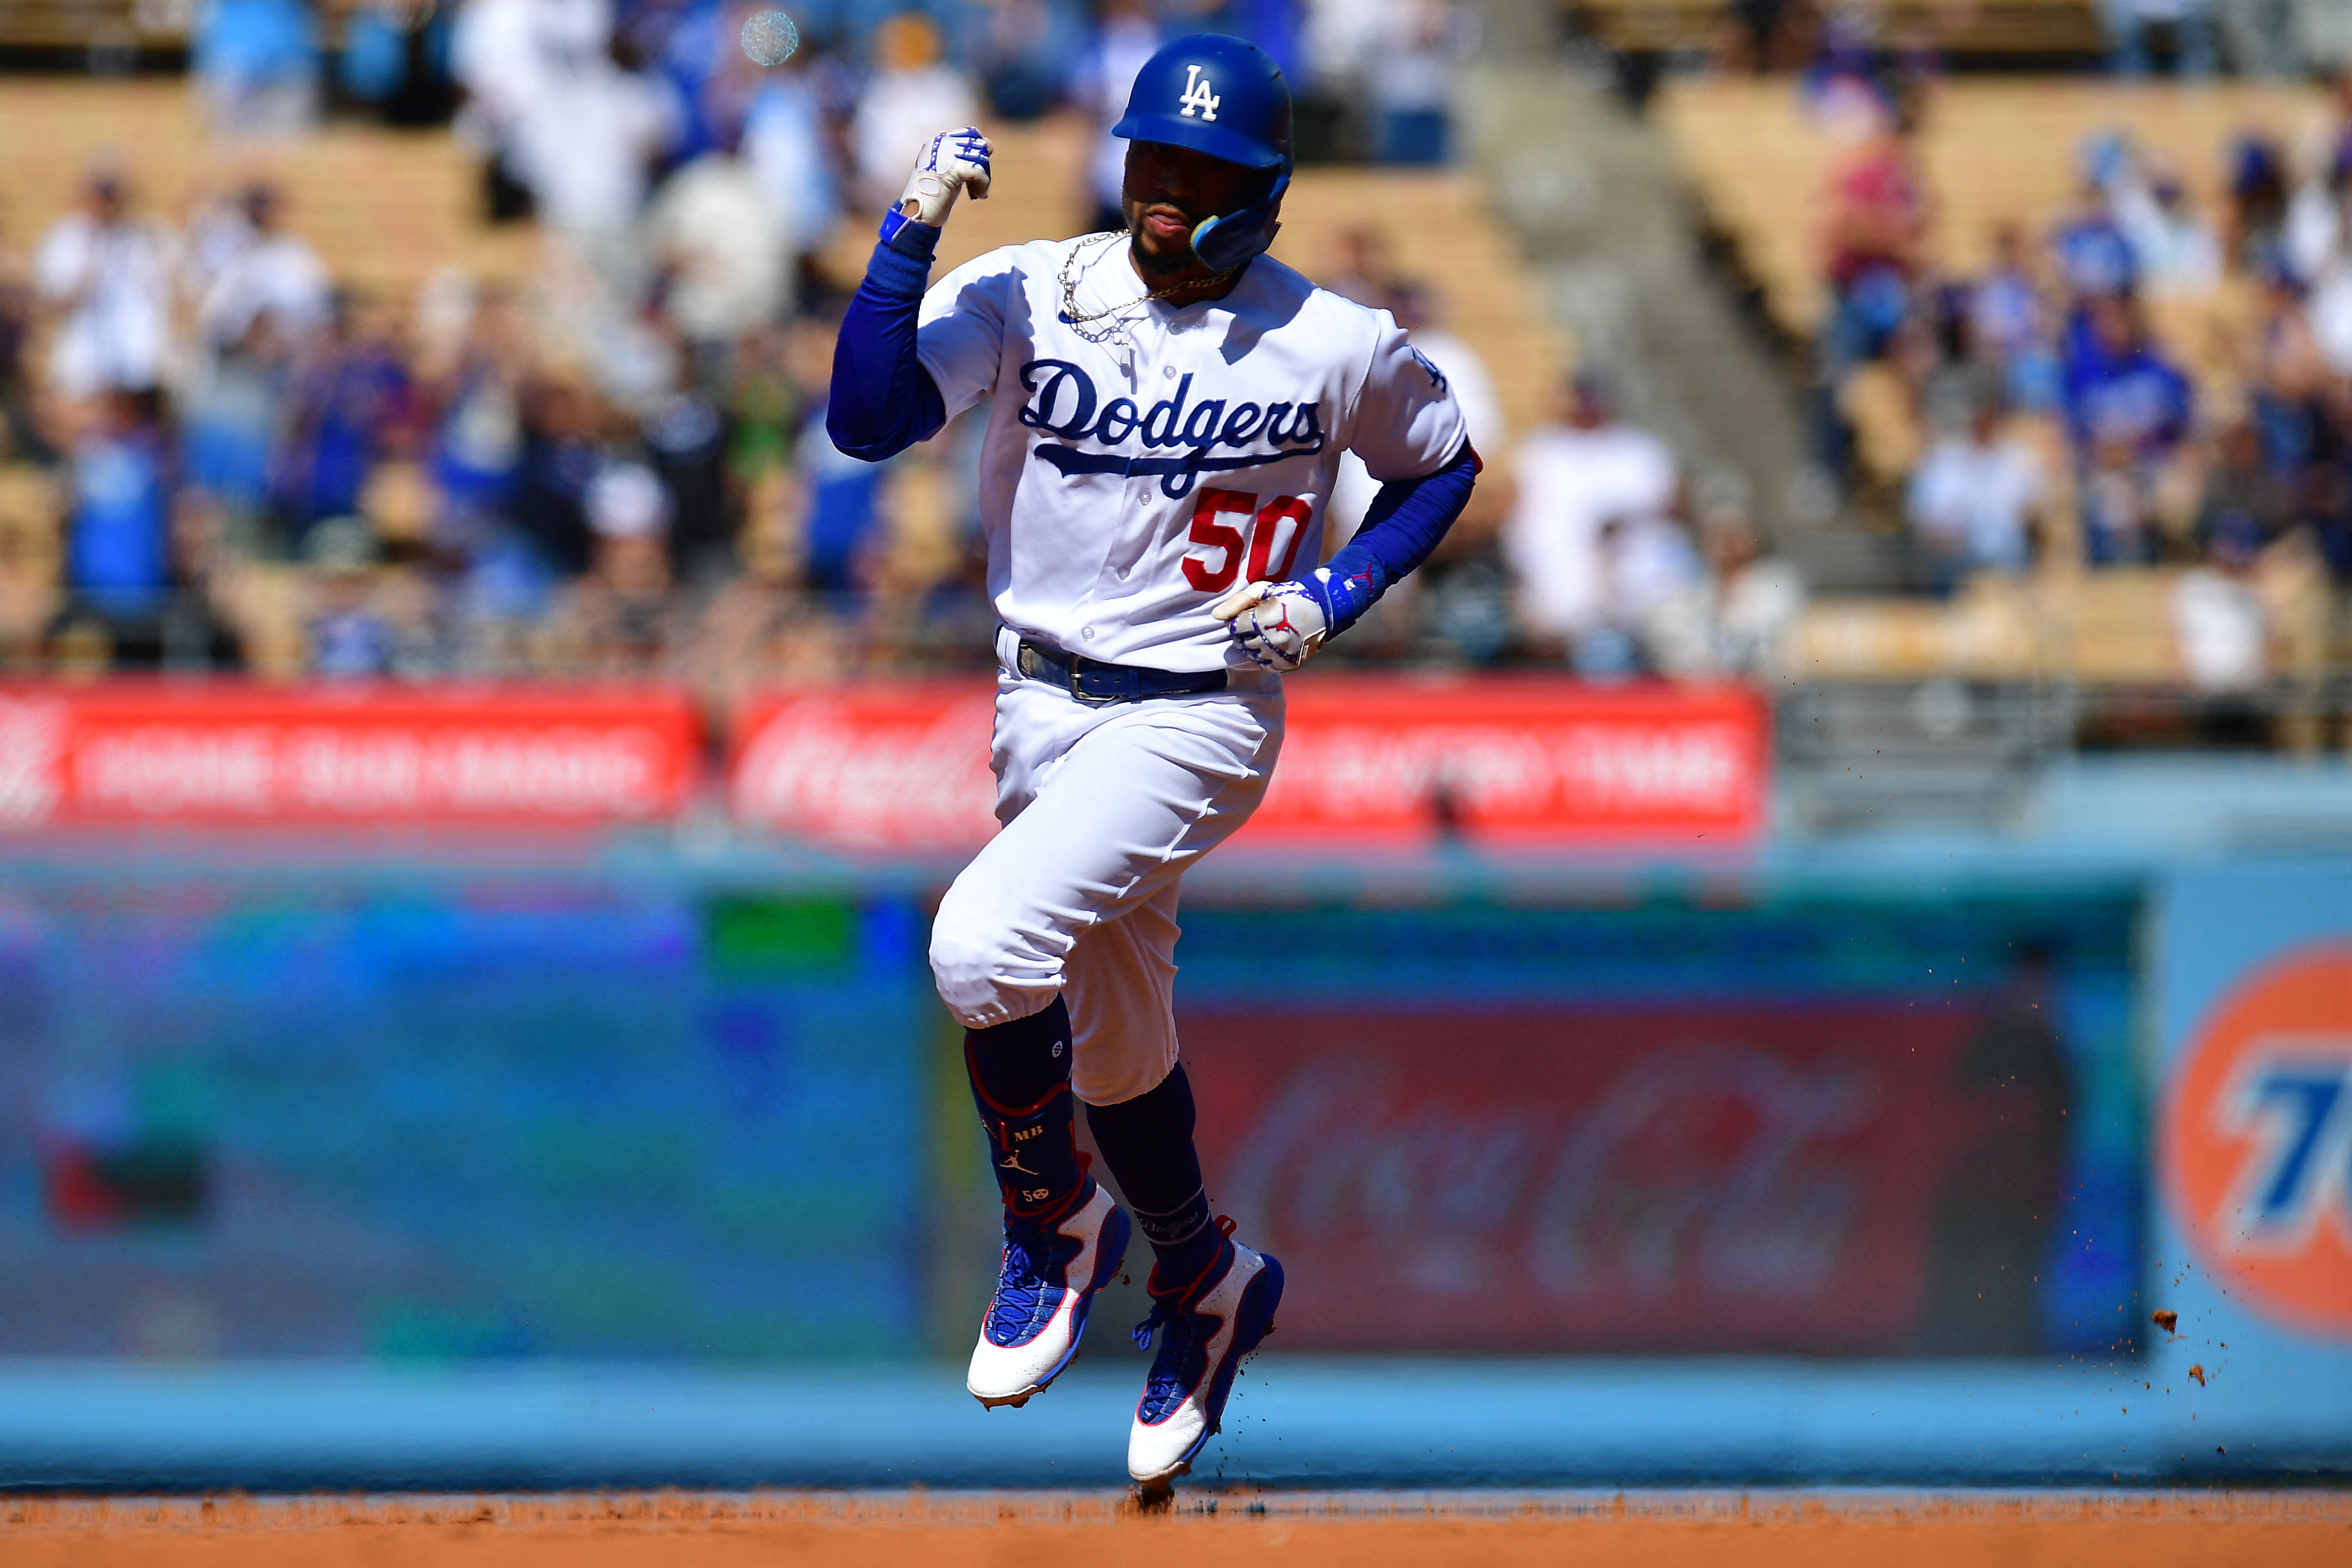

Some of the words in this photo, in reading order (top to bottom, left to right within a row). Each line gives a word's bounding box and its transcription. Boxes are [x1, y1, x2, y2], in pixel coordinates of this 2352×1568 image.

[1178, 64, 1221, 122] LA
[1018, 359, 1325, 499] Dodgers
[1181, 487, 1312, 594] 50
[1013, 1125, 1044, 1142] MB
